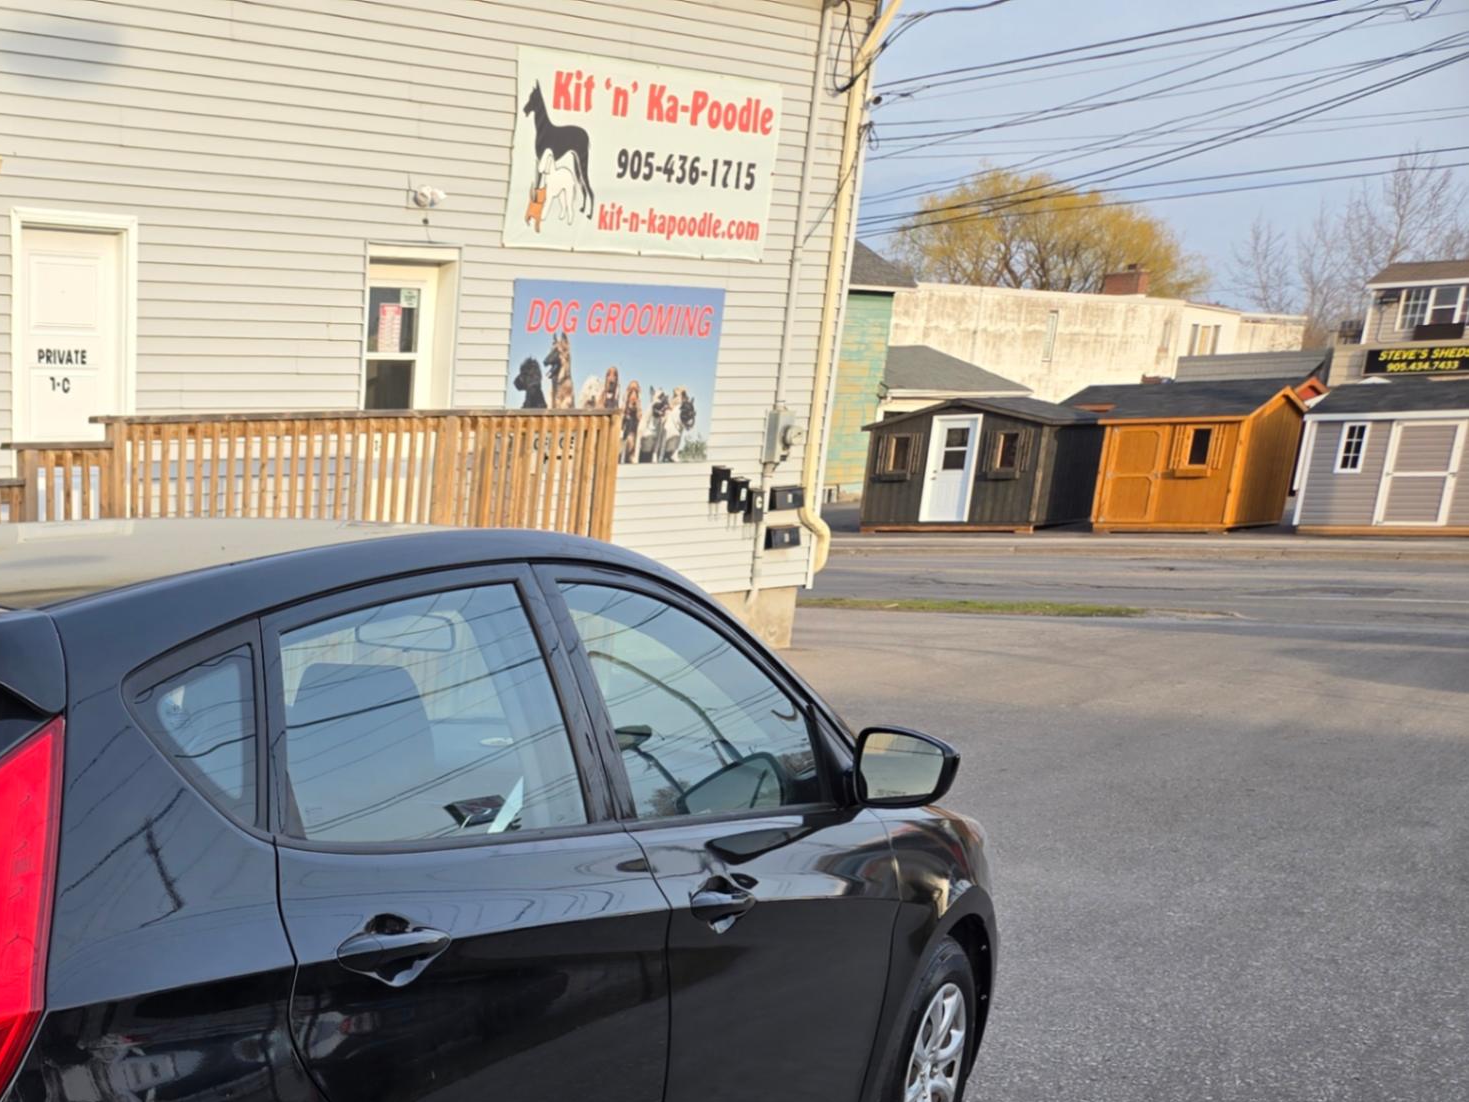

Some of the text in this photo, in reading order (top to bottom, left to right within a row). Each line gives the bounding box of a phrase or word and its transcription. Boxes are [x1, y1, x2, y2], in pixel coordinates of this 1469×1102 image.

[553, 70, 594, 112] Kit
[647, 83, 773, 136] Ka-Poodle
[616, 148, 756, 191] 905-436-1715
[598, 202, 759, 240] kit-n-kapoodle.com
[526, 299, 713, 337] DOG GROOMING
[37, 349, 87, 365] PRIVATE
[1378, 349, 1429, 361] STEVE'S
